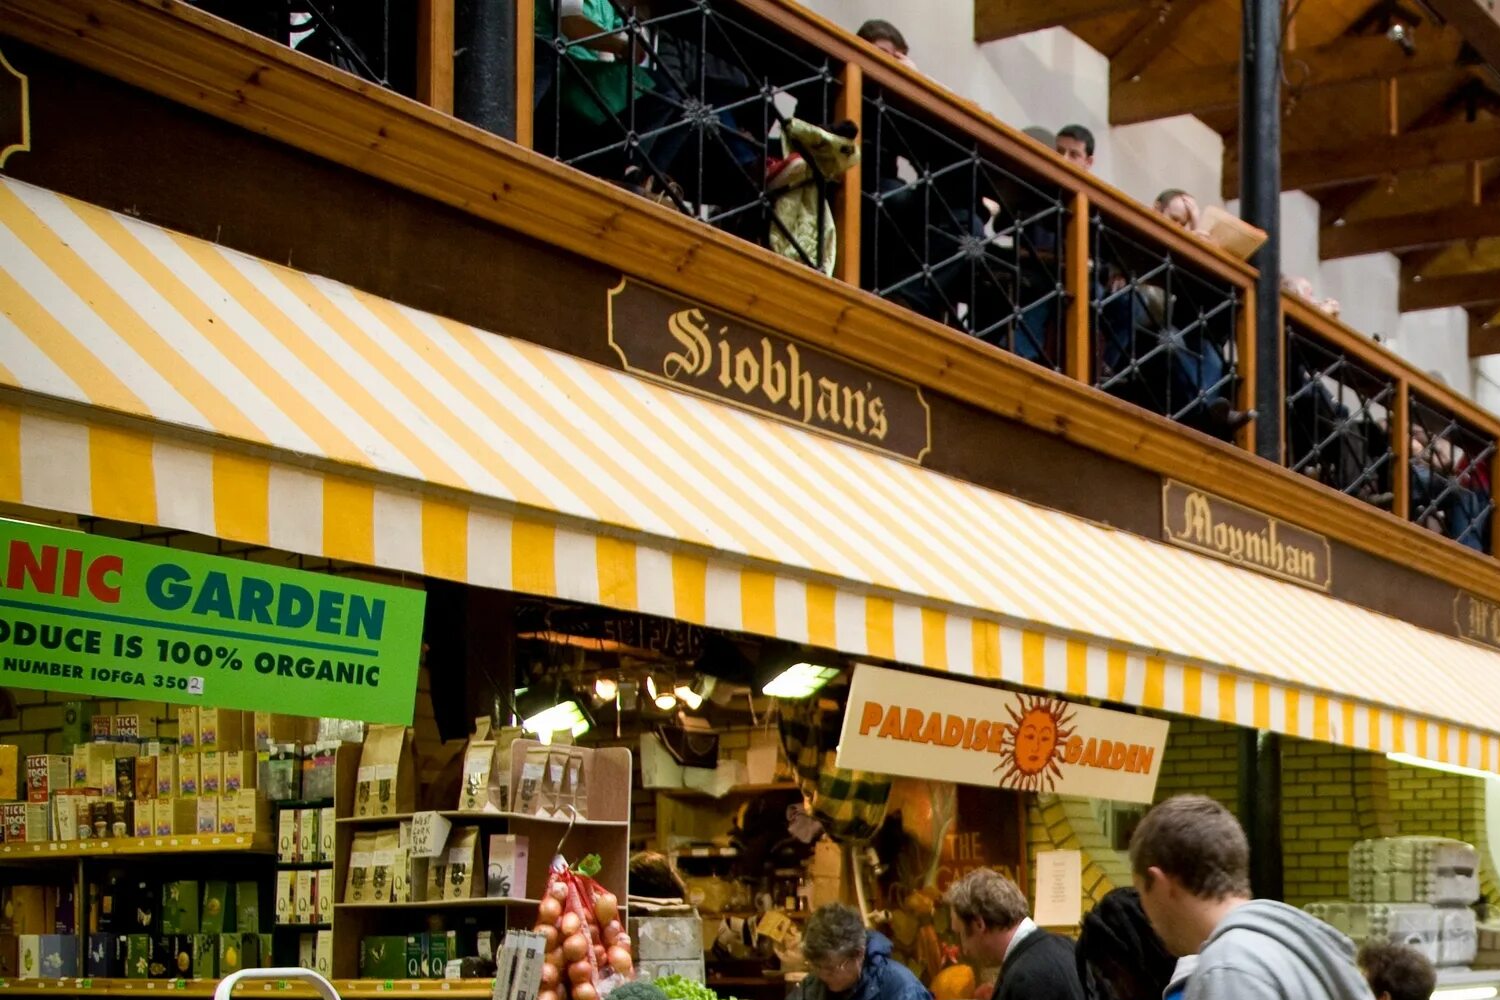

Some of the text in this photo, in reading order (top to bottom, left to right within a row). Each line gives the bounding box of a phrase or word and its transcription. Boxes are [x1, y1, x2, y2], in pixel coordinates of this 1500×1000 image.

[1177, 492, 1316, 579] Moynihan
[0, 539, 386, 641] NIC GARDEN
[3, 657, 84, 680] NUMBER
[91, 667, 145, 686] IOFGA
[113, 633, 144, 659] IS
[157, 639, 243, 672] 100%
[254, 652, 381, 687] ORGANIC
[116, 716, 137, 727] TICK
[859, 700, 1155, 775] PARADISE GARDEN
[27, 756, 47, 768] TICK
[5, 804, 26, 815] TICK
